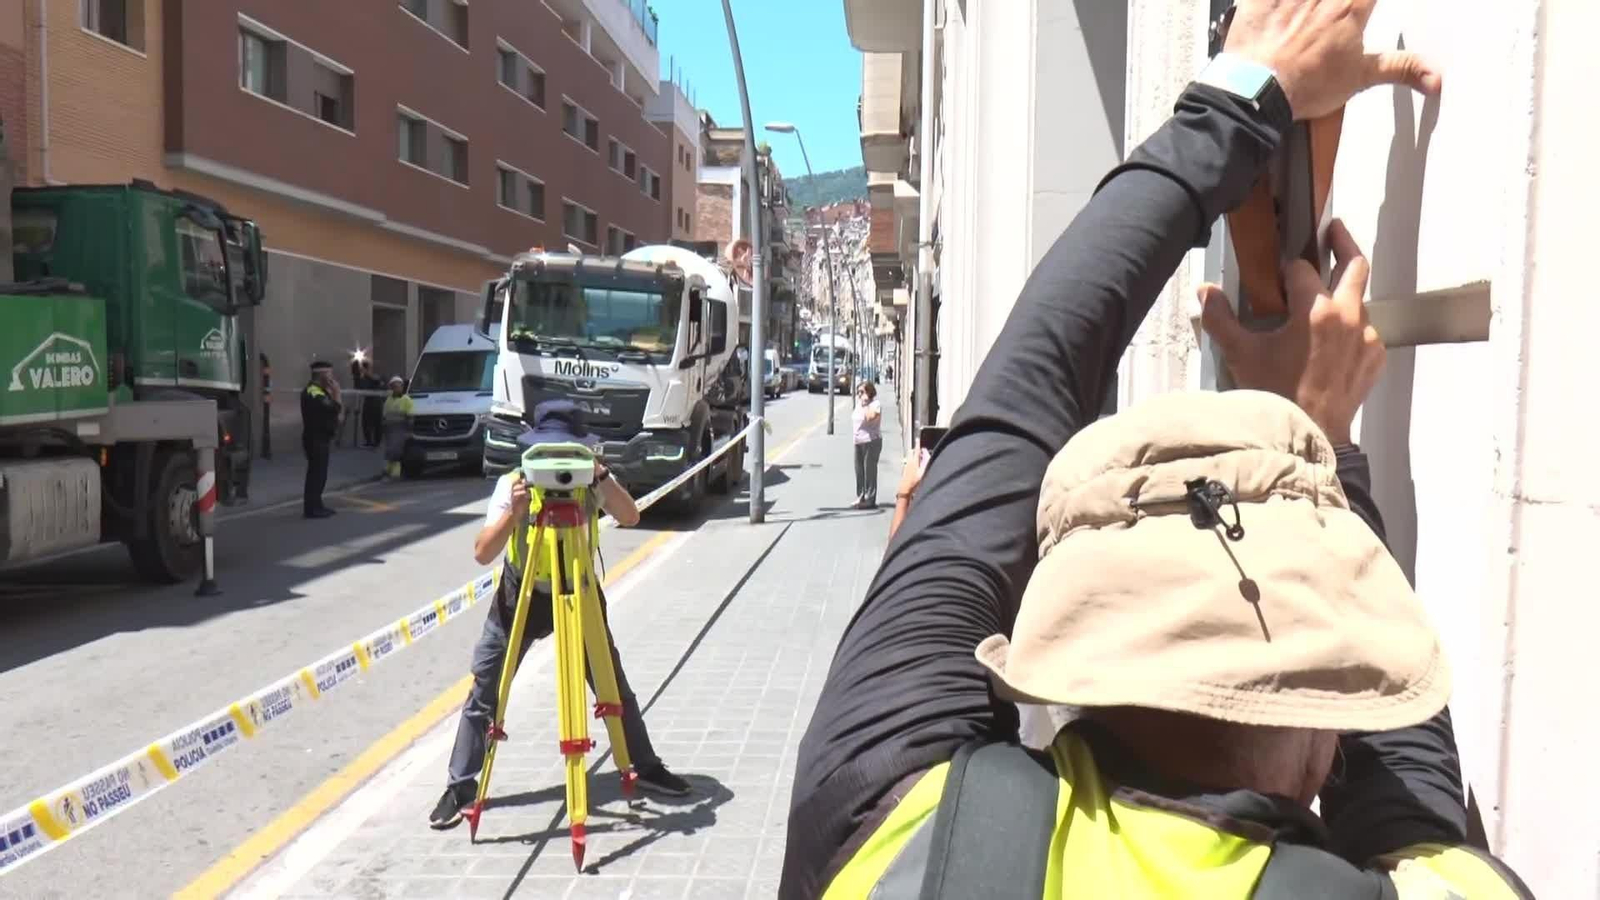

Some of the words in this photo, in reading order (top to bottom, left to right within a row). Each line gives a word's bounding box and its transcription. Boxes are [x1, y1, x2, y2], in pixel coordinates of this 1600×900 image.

[29, 365, 94, 389] VALERO
[554, 360, 610, 379] Molins
[173, 746, 206, 773] POLICIA
[82, 800, 99, 819] NO
[98, 782, 132, 811] PASSEU
